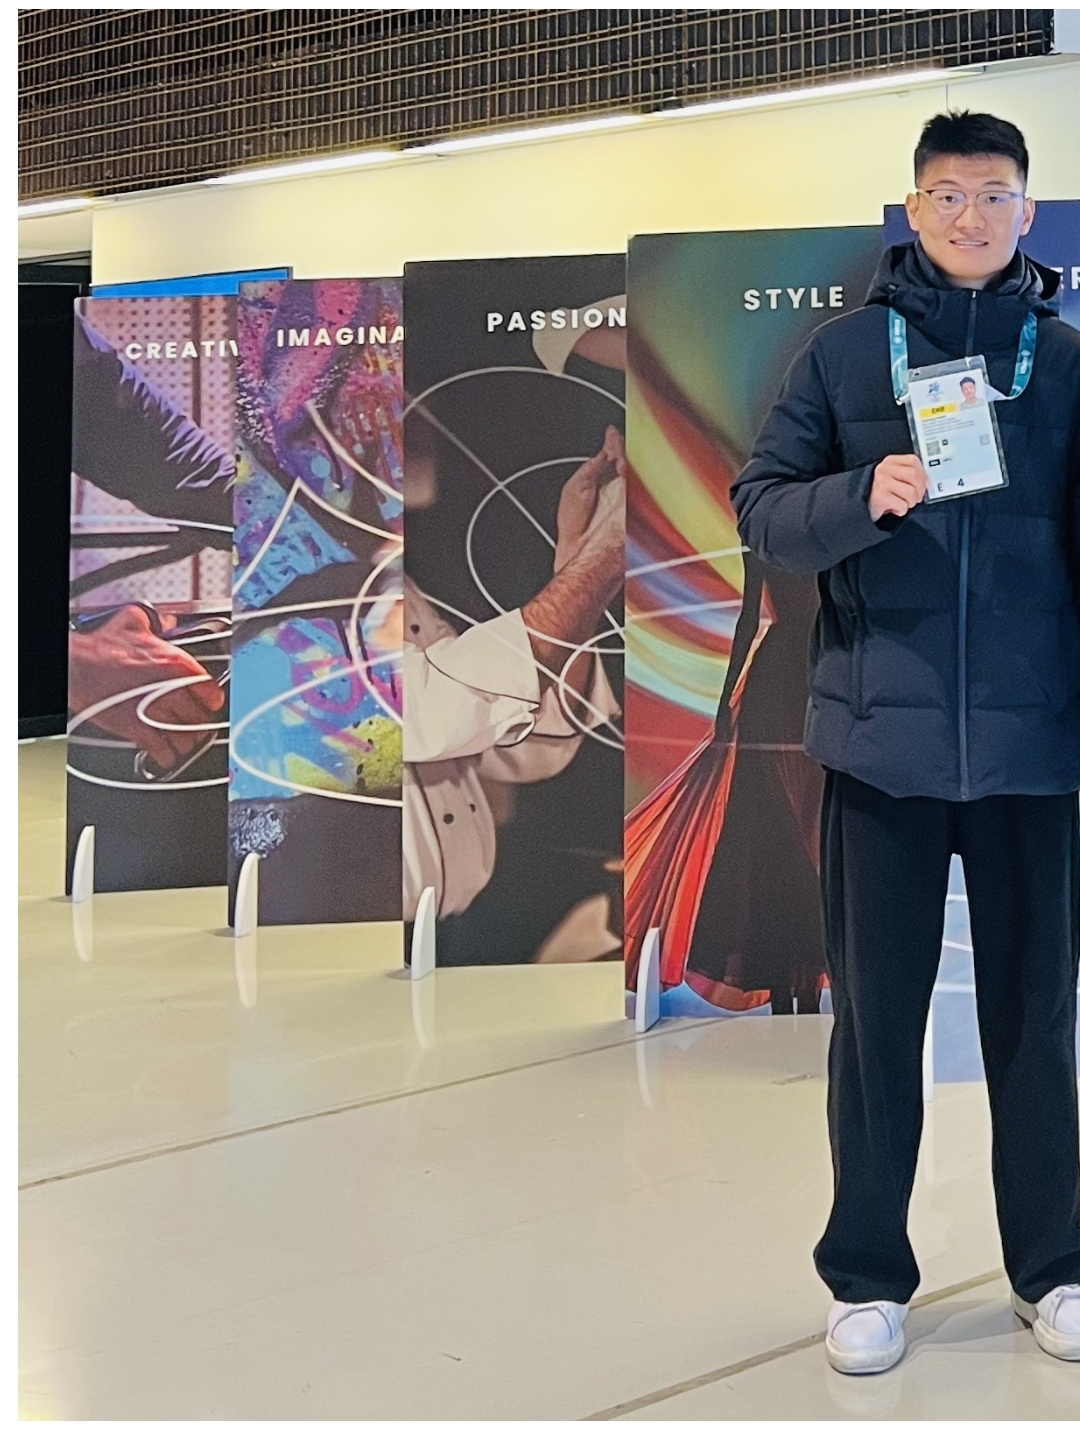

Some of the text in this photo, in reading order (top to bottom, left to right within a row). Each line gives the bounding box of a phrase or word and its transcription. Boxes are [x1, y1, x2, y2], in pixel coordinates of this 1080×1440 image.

[743, 286, 844, 311] STYLE
[487, 307, 627, 333] PASSION
[276, 325, 405, 348] IMAGINA
[937, 478, 965, 492] E 4
